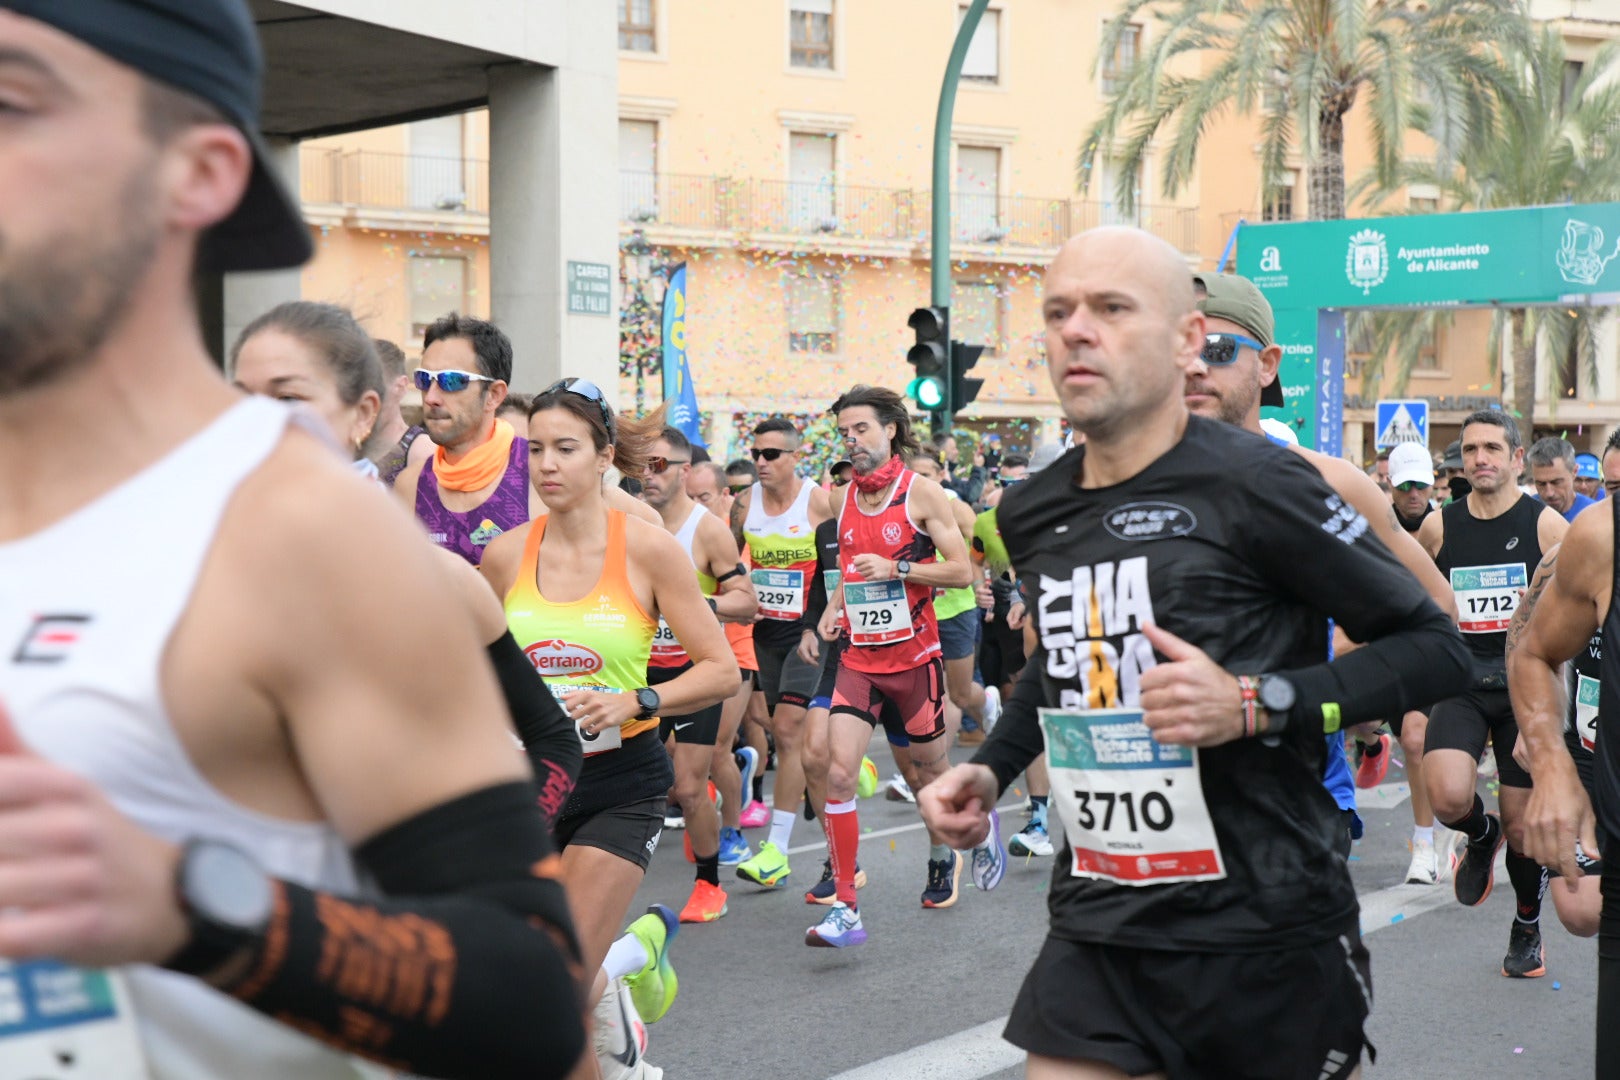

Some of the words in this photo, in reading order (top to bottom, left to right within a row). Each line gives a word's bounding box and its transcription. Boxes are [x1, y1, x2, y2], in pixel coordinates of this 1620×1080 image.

[1397, 243, 1490, 259] Ayuntamiento
[576, 264, 609, 279] CARRER
[1407, 260, 1424, 273] de
[1426, 257, 1479, 272] Alicante
[758, 591, 794, 605] 2297
[1467, 596, 1514, 614] 1712
[859, 609, 893, 626] 729
[1038, 573, 1077, 679] CITY
[530, 652, 595, 669] Serrano
[1074, 790, 1174, 832] 3710
